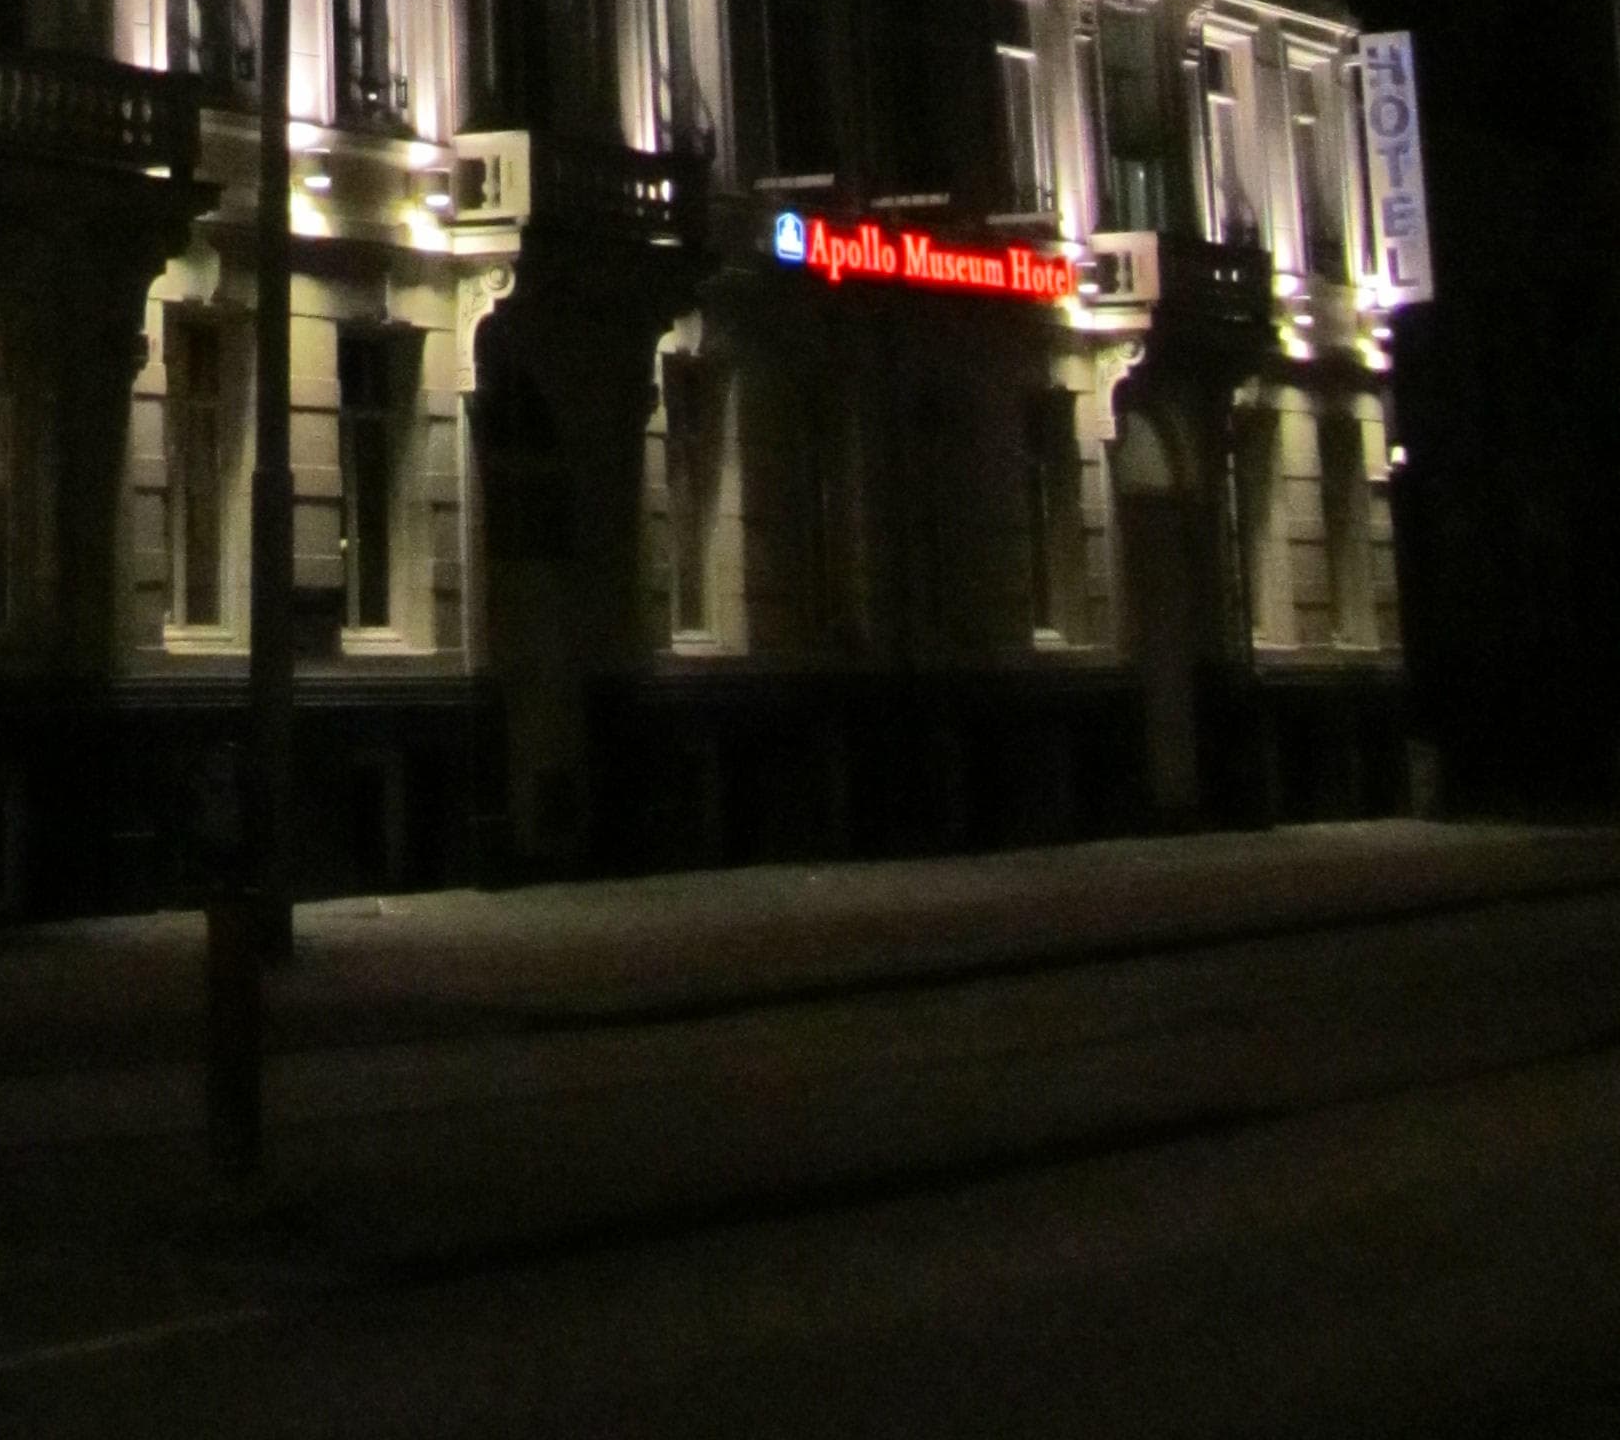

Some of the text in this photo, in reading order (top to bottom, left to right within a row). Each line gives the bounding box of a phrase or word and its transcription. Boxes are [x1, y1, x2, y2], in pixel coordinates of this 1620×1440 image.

[1366, 44, 1419, 287] HOTEL
[807, 220, 1074, 294] Apollo Museum Hotel
